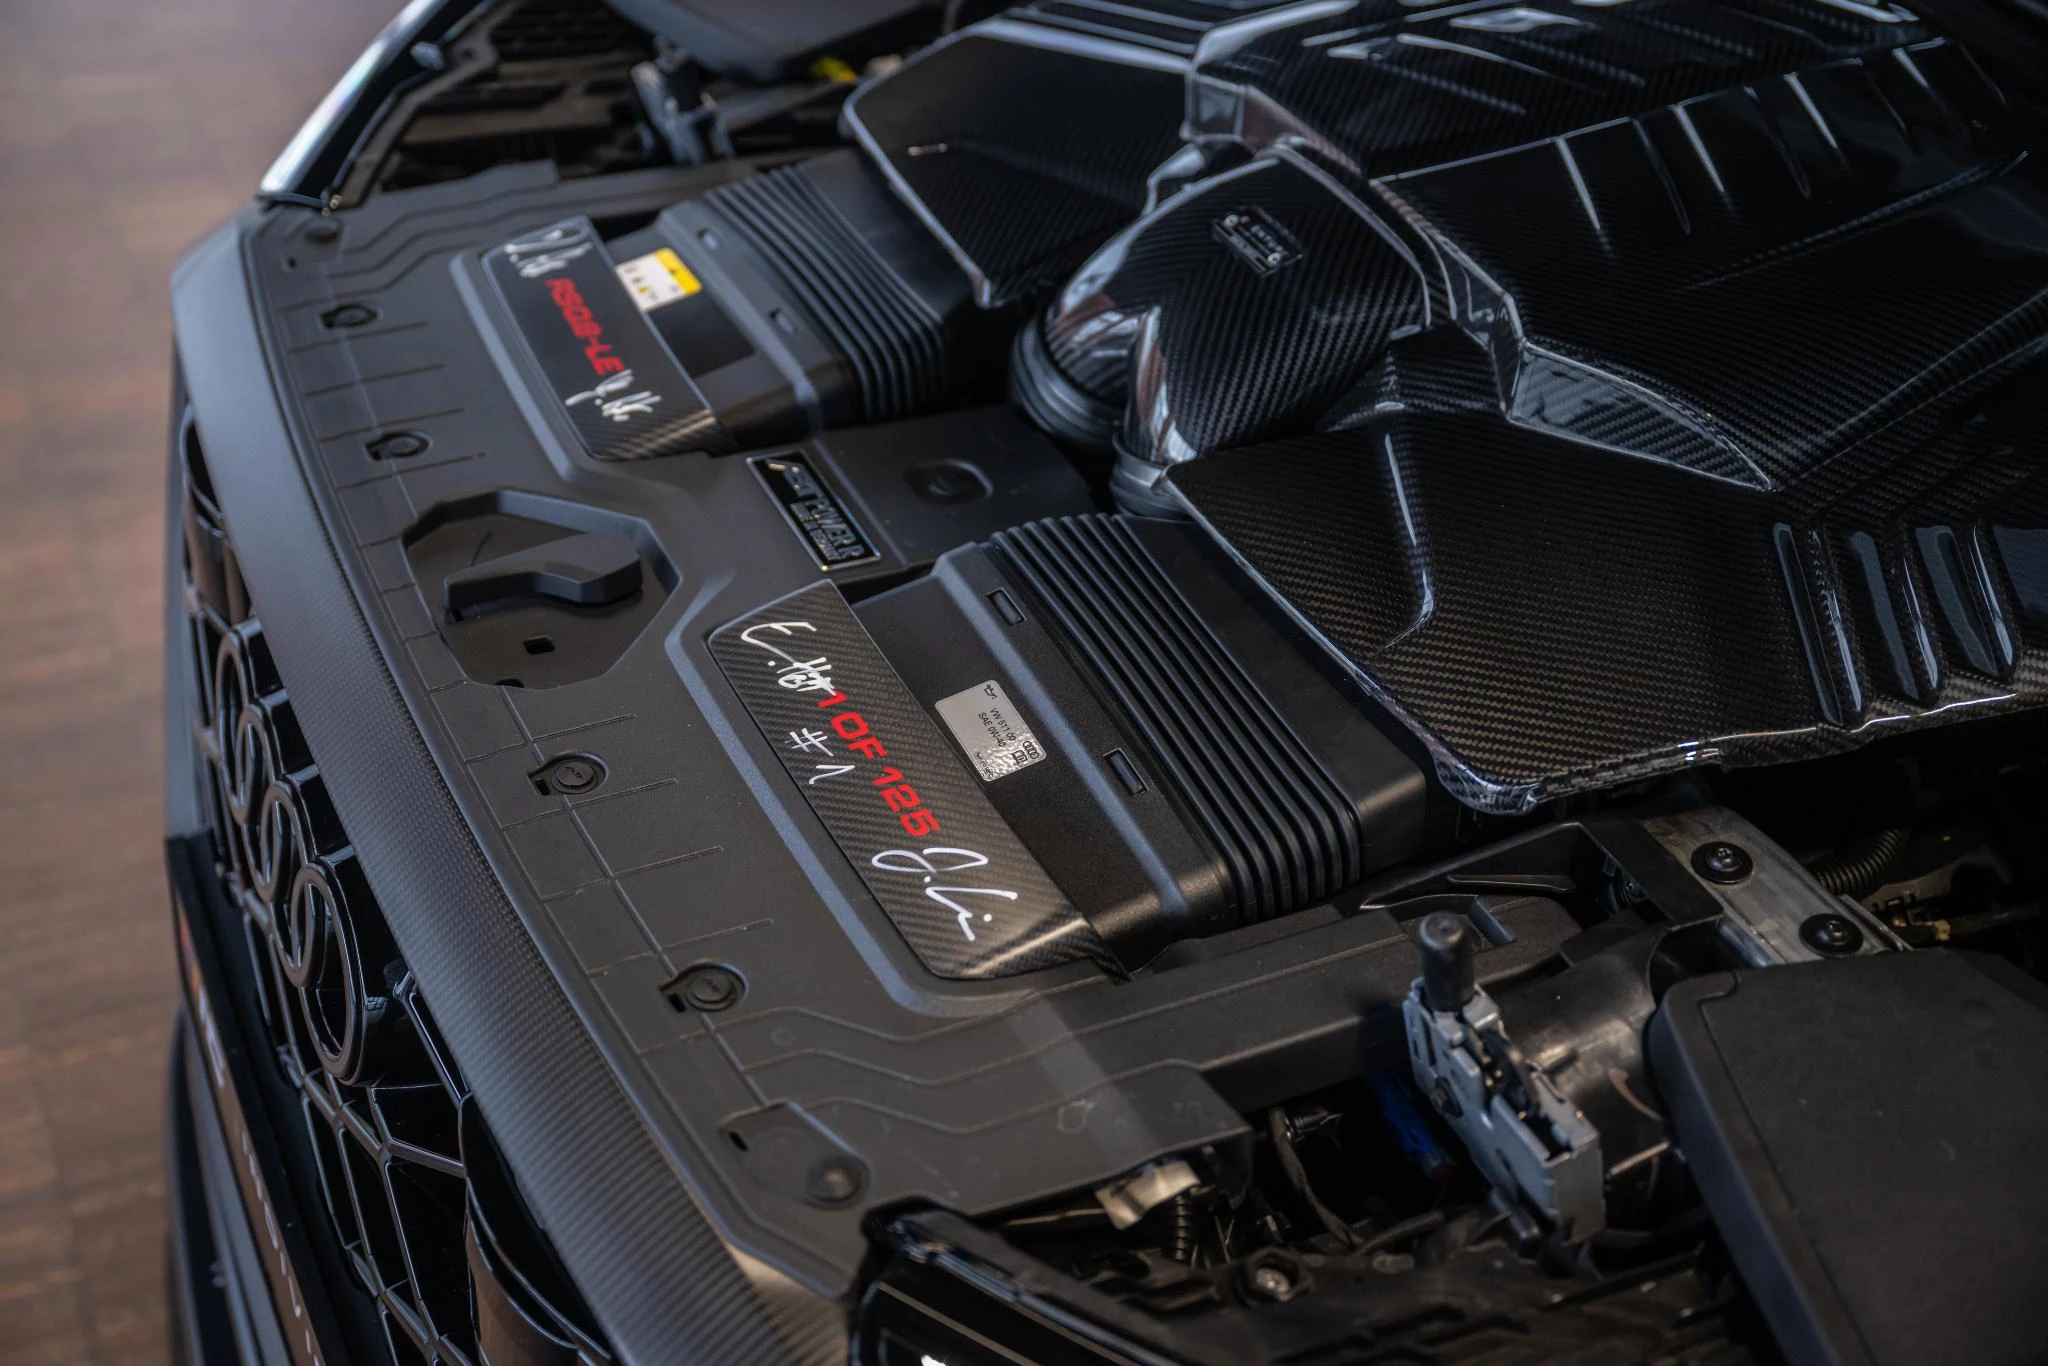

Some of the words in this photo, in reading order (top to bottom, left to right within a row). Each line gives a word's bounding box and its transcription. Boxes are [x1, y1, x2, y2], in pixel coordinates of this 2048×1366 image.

[818, 690, 848, 708] 1
[831, 711, 887, 759] OF
[978, 711, 993, 727] SAE
[988, 726, 1007, 747] 0W-40
[990, 707, 1004, 721] VW
[998, 719, 1011, 733] 511
[872, 766, 940, 837] 125
